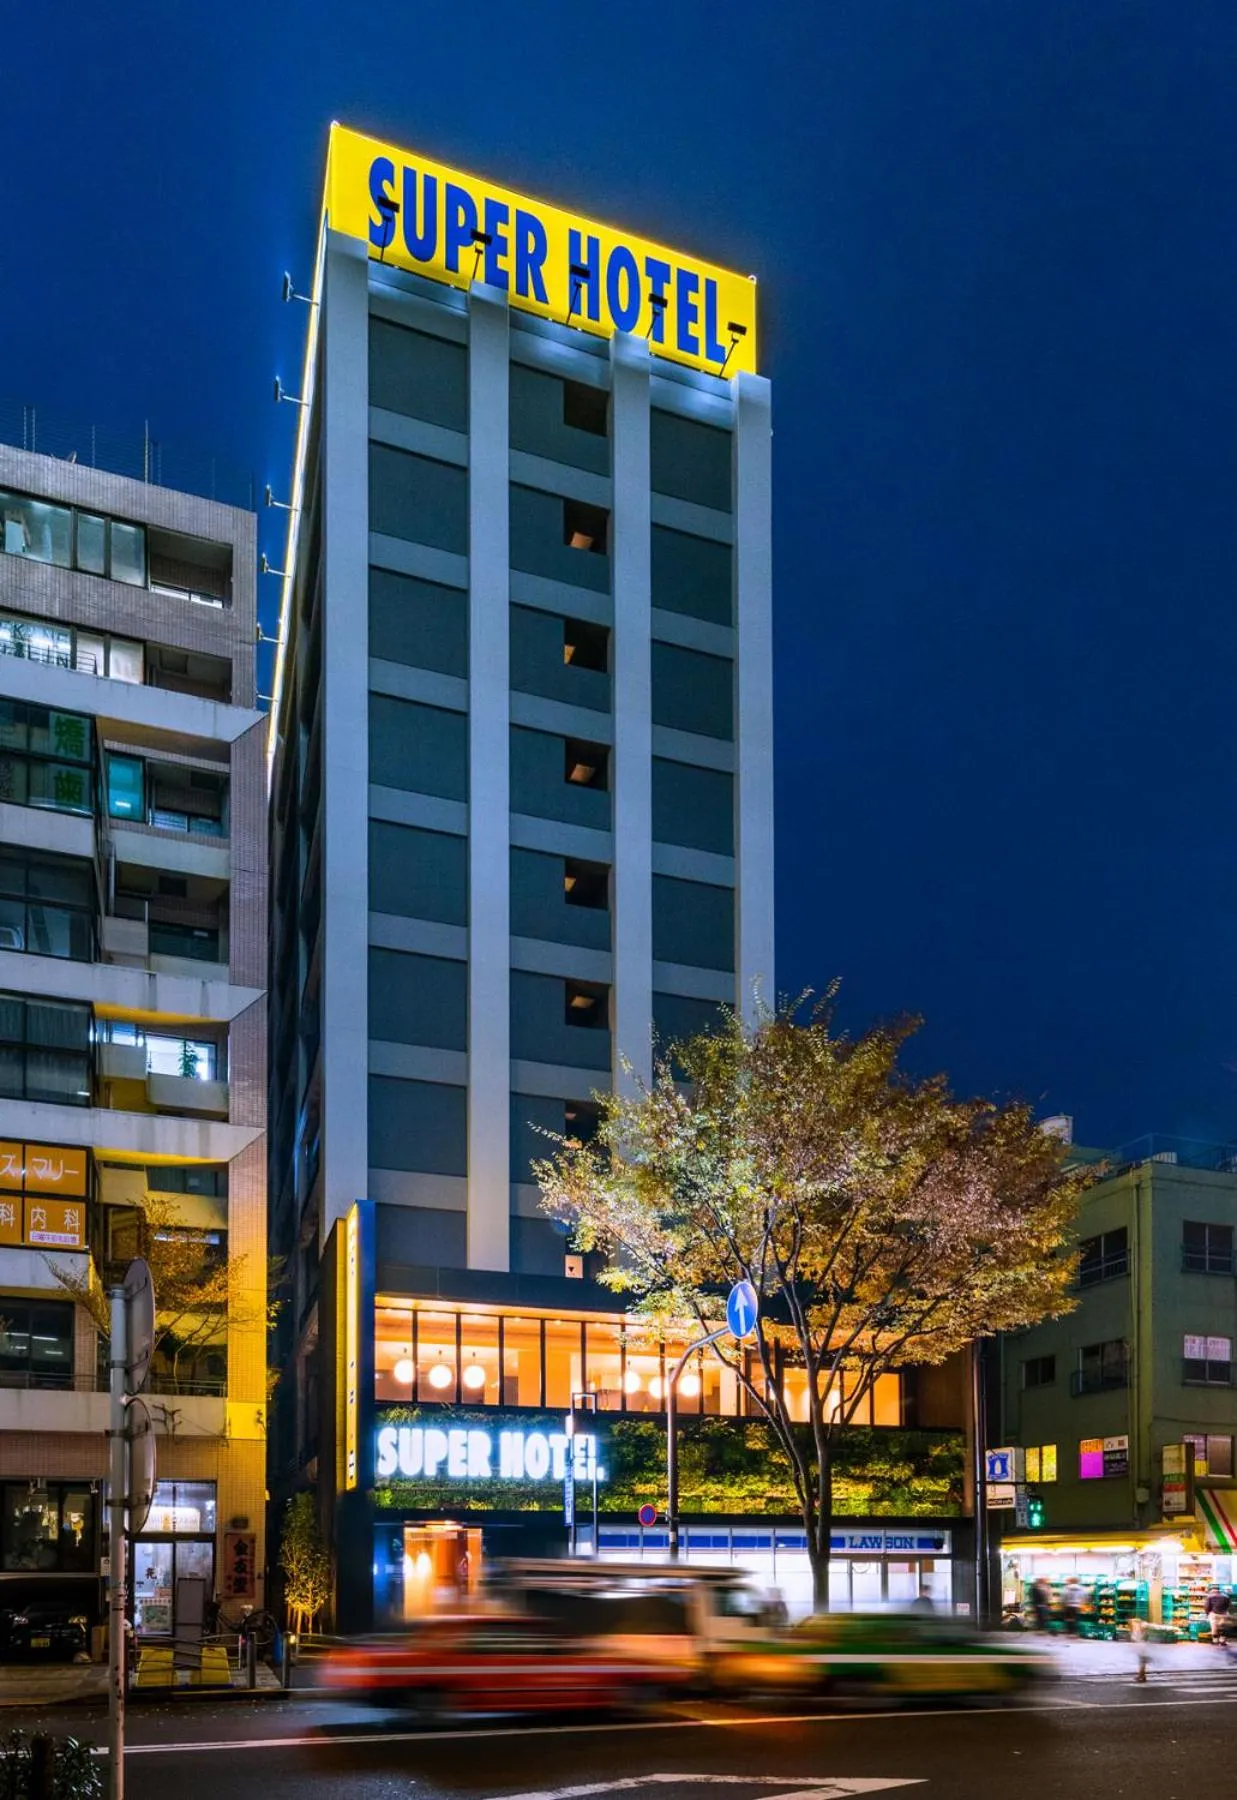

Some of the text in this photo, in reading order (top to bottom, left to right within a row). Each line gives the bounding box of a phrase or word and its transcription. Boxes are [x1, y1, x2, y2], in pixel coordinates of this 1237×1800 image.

[367, 156, 726, 365] SUPER HOTEL
[376, 1426, 606, 1481] SUPER HOTEL
[849, 1535, 914, 1549] LAWSON
